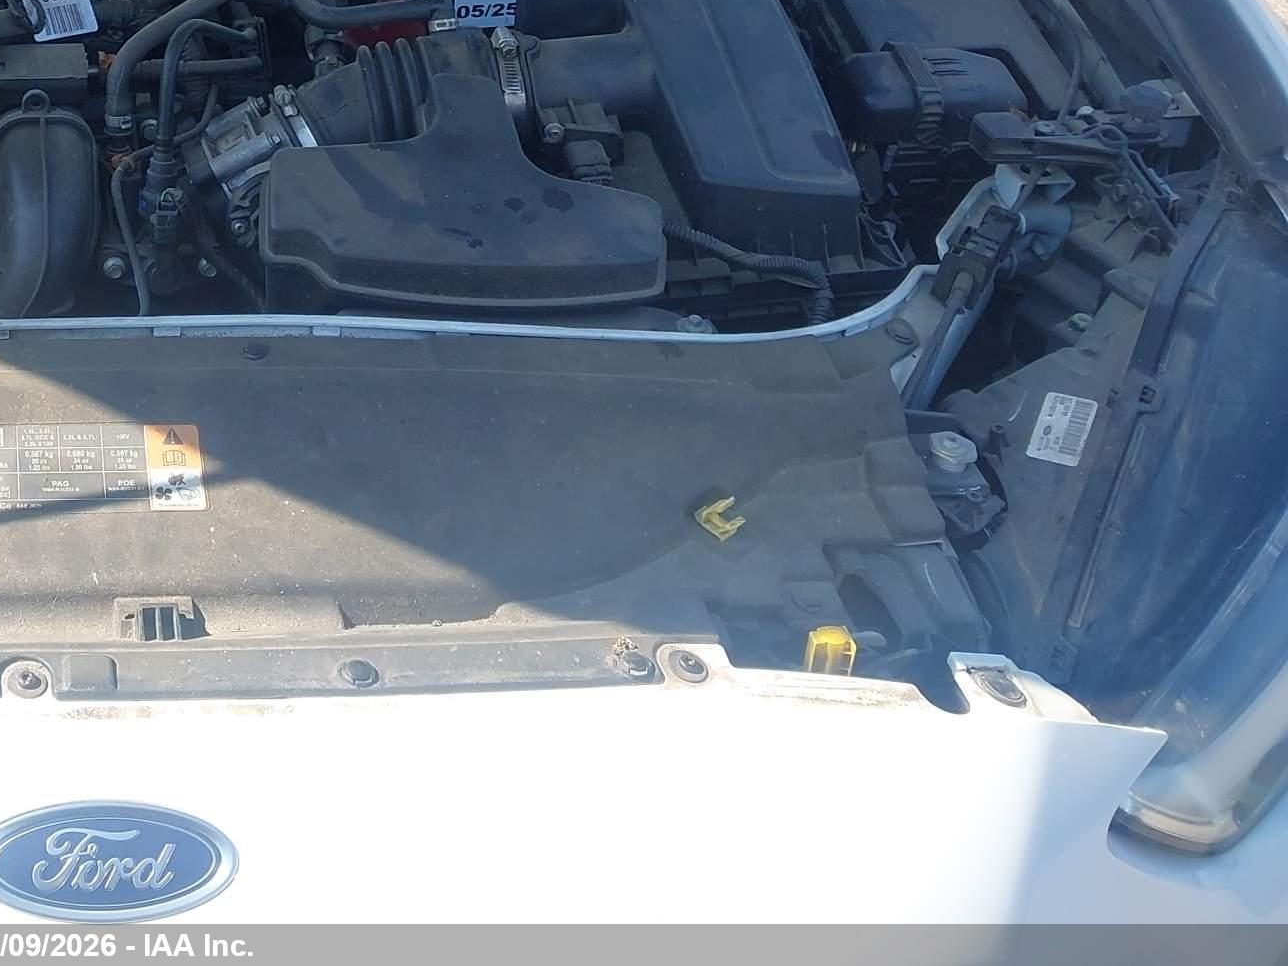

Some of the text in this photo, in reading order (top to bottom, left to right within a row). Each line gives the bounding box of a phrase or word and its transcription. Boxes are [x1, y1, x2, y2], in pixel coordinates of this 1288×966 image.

[456, 2, 517, 19] 05/25
[117, 479, 136, 487] POE
[31, 827, 178, 892] Ford
